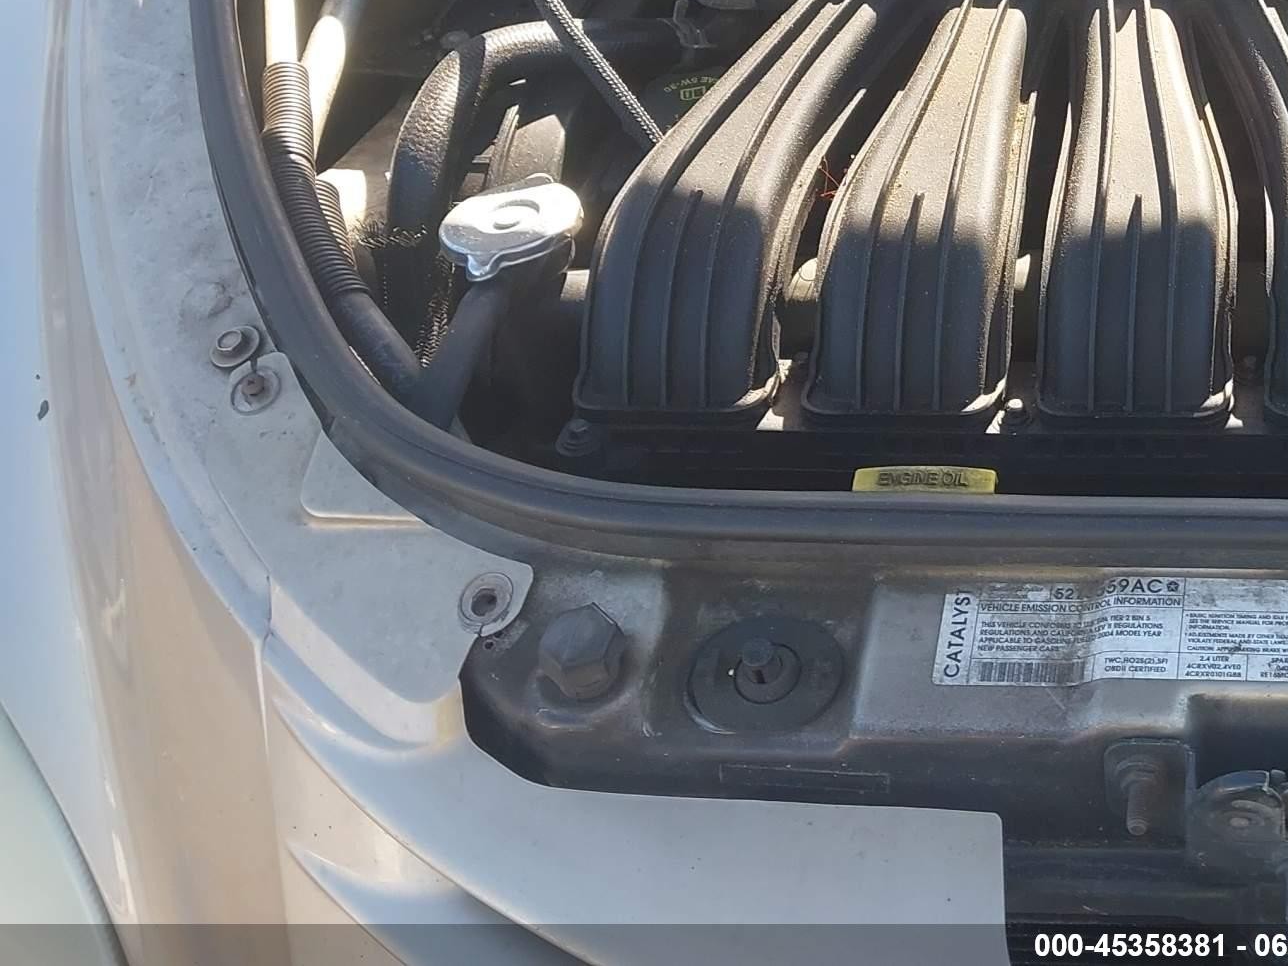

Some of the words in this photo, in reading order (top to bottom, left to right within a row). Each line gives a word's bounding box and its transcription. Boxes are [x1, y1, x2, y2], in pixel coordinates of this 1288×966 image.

[878, 472, 938, 486] ENGINE
[942, 472, 969, 486] OIL
[981, 603, 1021, 611] VEHICLE
[1021, 604, 1068, 612] EMISSION
[1069, 598, 1111, 613] CONTROL
[1113, 597, 1181, 606] INFORMATION
[944, 589, 973, 677] CATALYST
